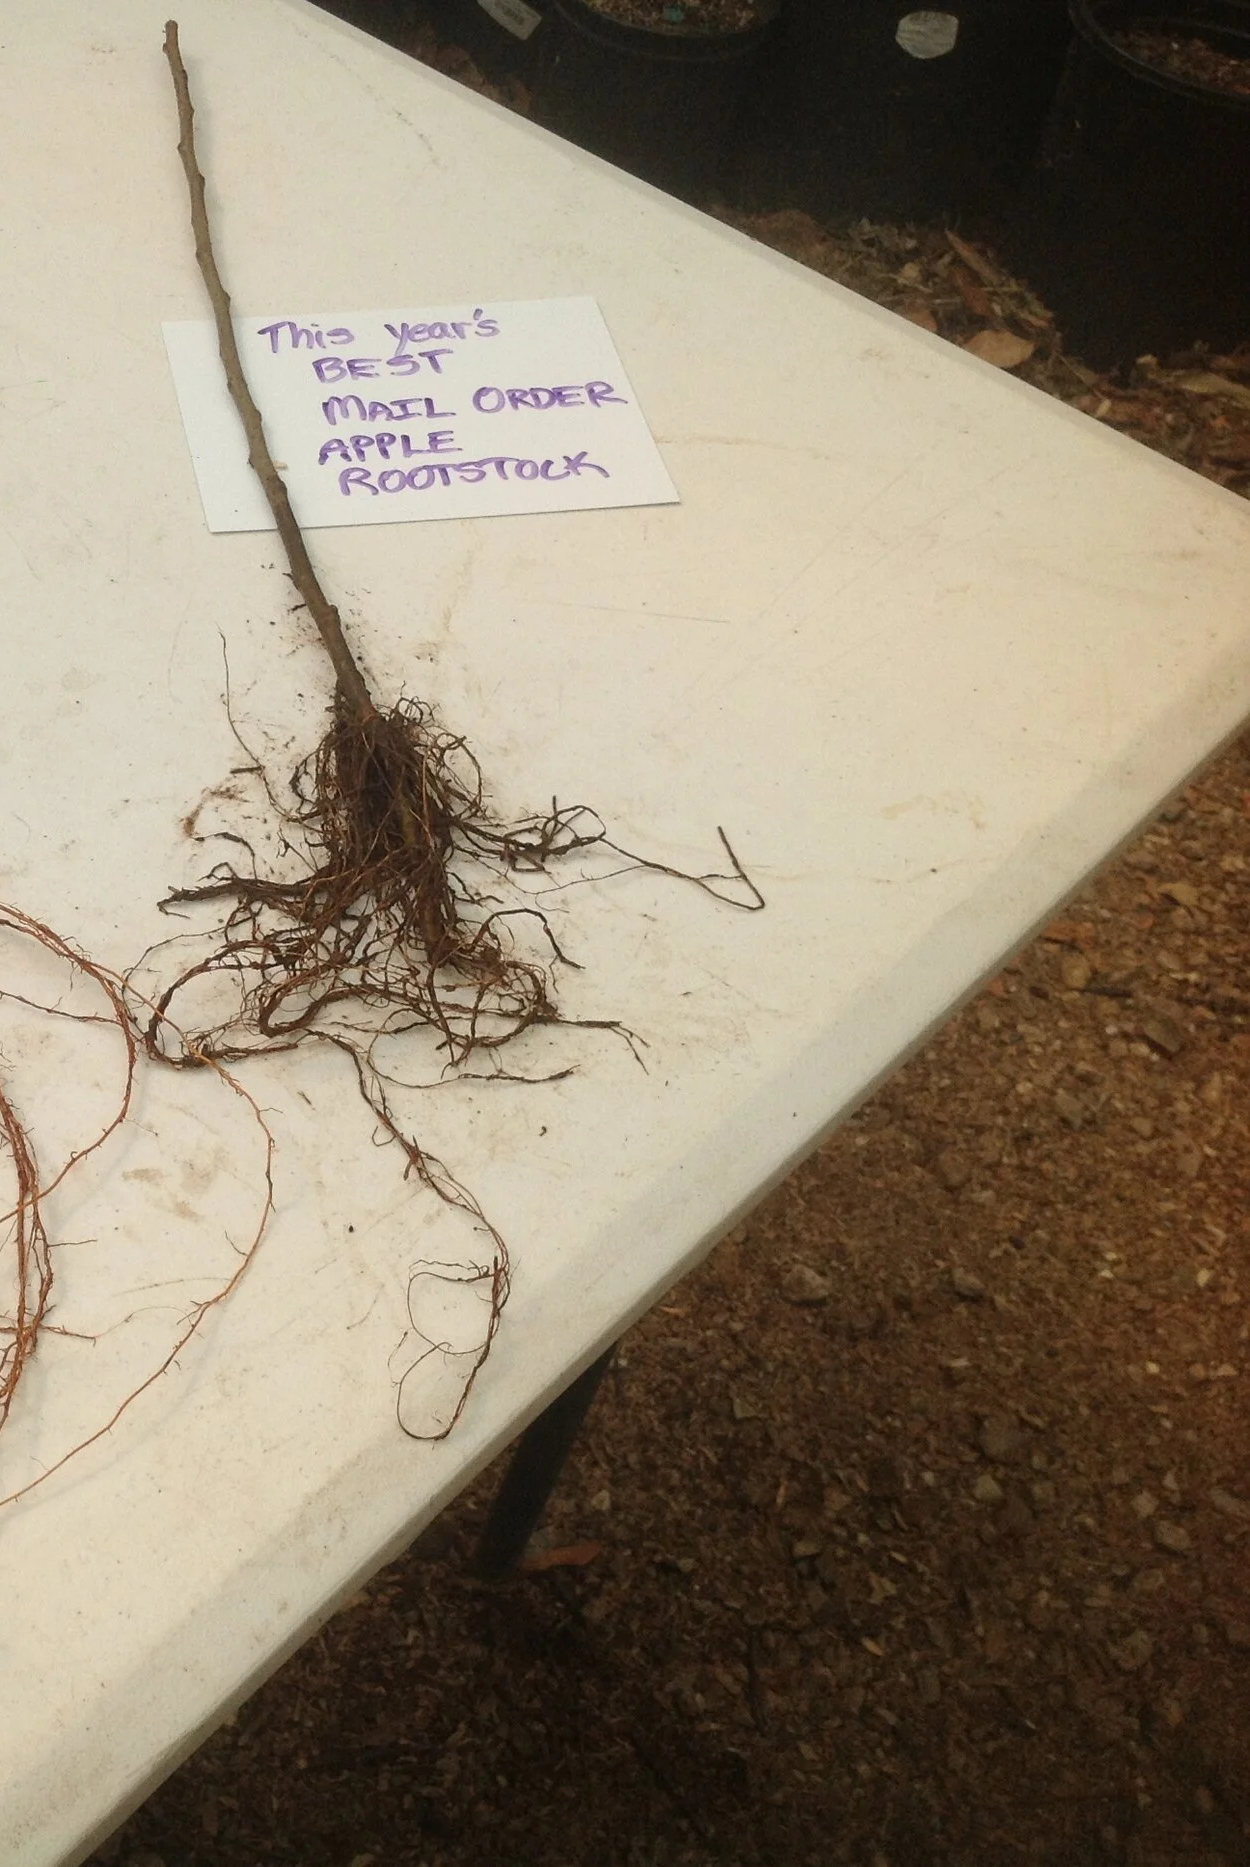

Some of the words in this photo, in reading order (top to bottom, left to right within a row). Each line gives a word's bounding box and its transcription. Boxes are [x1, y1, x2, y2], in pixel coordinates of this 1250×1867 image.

[257, 320, 355, 354] This
[384, 308, 501, 356] year's
[312, 348, 454, 384] BEST
[322, 394, 456, 426] MAIL
[472, 380, 628, 414] ORDER
[318, 430, 463, 466] APPLE
[338, 450, 610, 497] ROOTSTOCK
